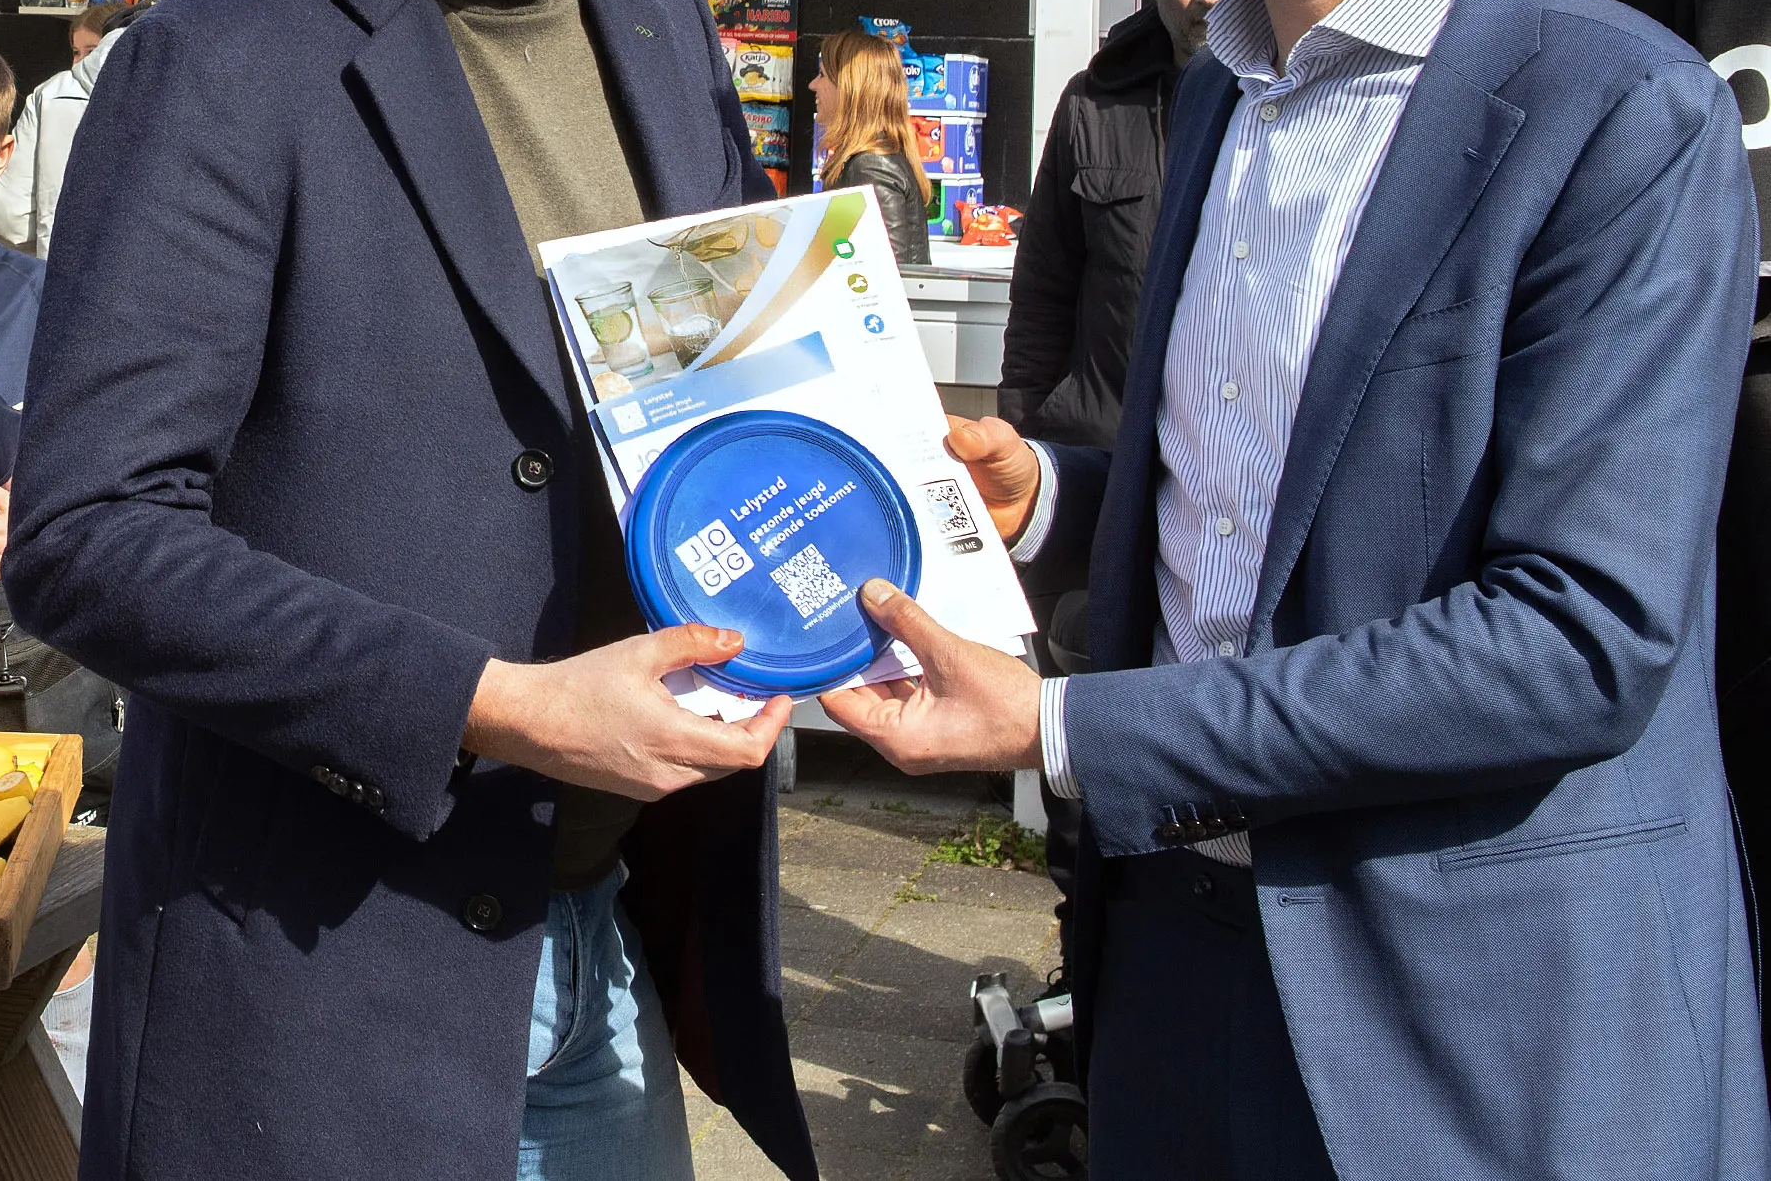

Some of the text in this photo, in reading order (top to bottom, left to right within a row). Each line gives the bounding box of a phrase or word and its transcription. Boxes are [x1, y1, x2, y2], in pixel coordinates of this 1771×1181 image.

[746, 8, 791, 23] HARIBO
[730, 475, 788, 522] Lelystad
[748, 480, 827, 544] gezonde jeugd
[759, 480, 857, 557] gezonde toekomst
